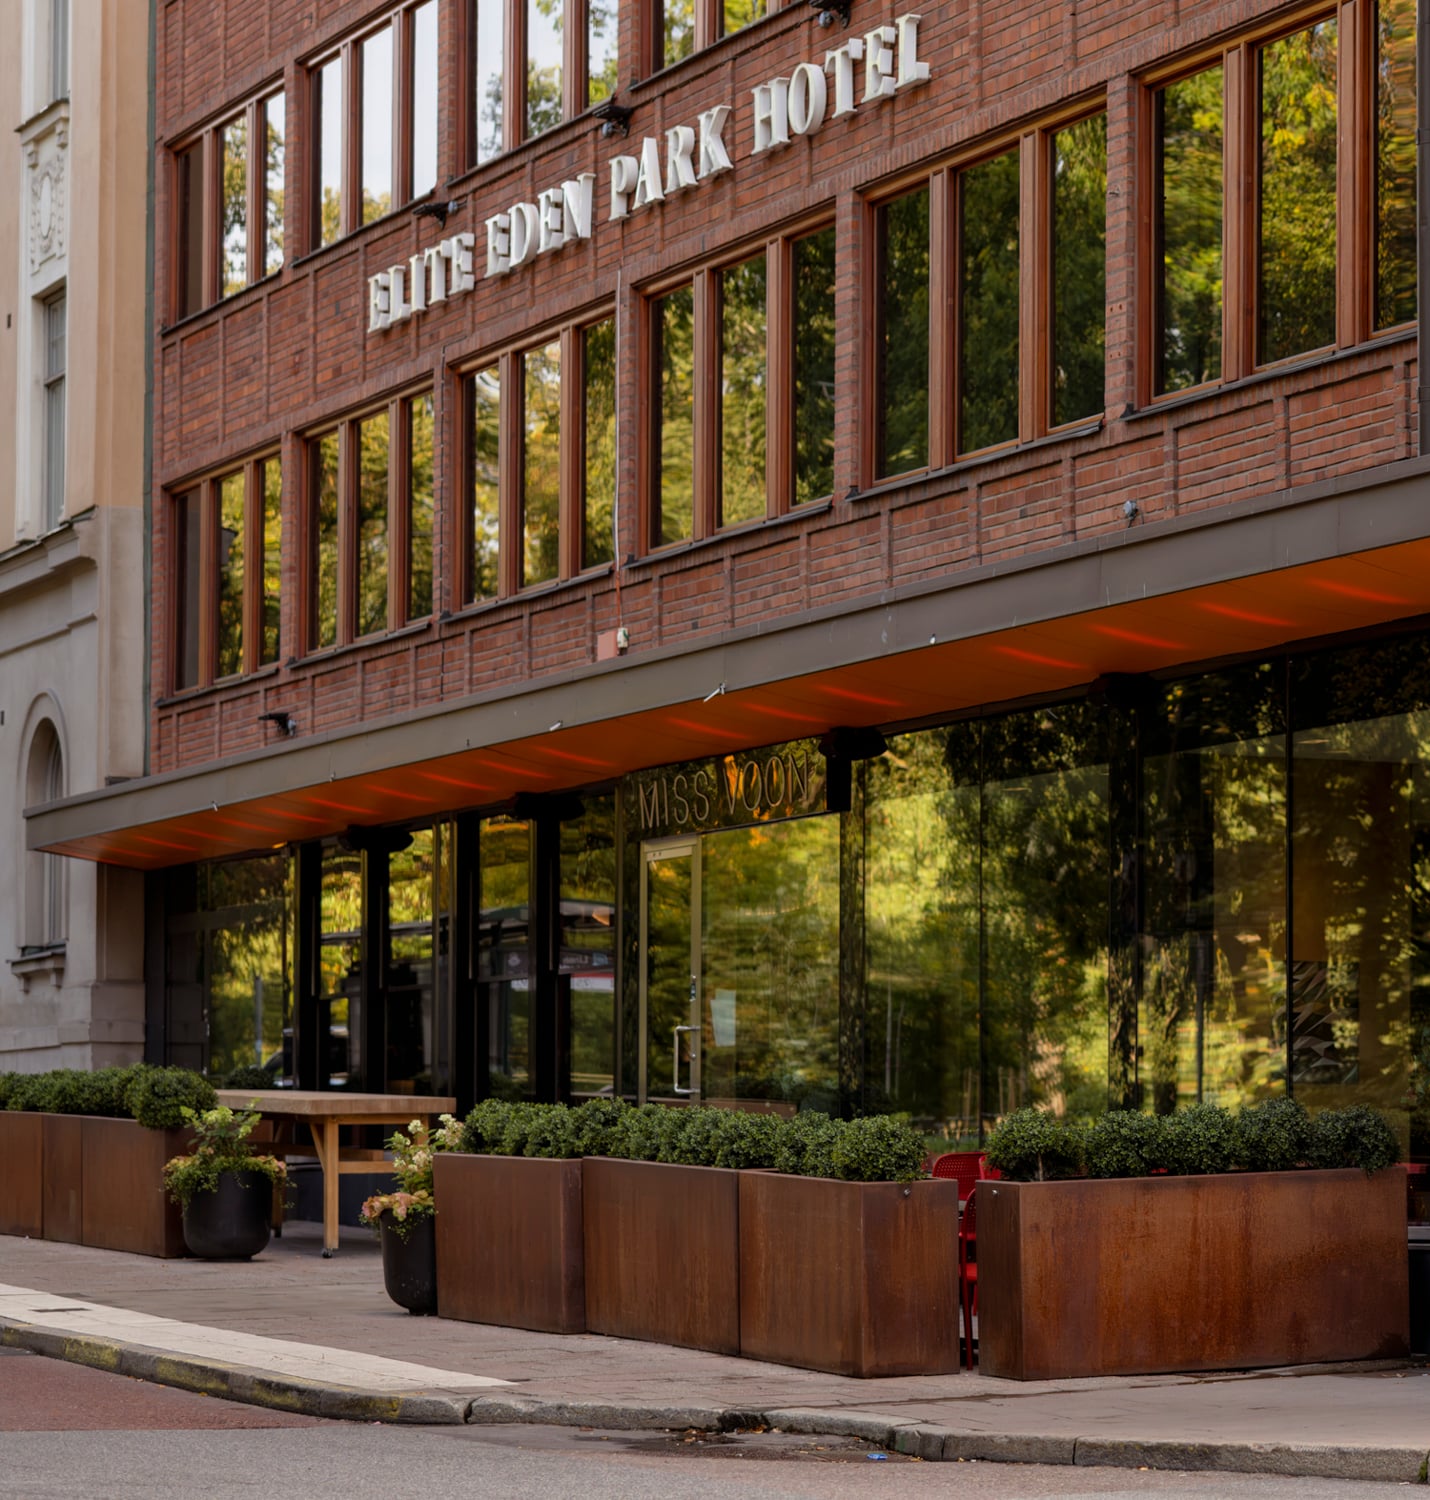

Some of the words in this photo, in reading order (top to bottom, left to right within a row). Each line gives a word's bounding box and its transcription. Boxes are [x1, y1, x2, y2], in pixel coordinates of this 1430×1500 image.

[367, 232, 475, 334] ELITE
[484, 172, 596, 279] EDEN
[608, 105, 734, 222] PARK
[751, 13, 931, 156] HOTEL
[638, 771, 710, 830] MISS
[722, 751, 809, 816] VOON
